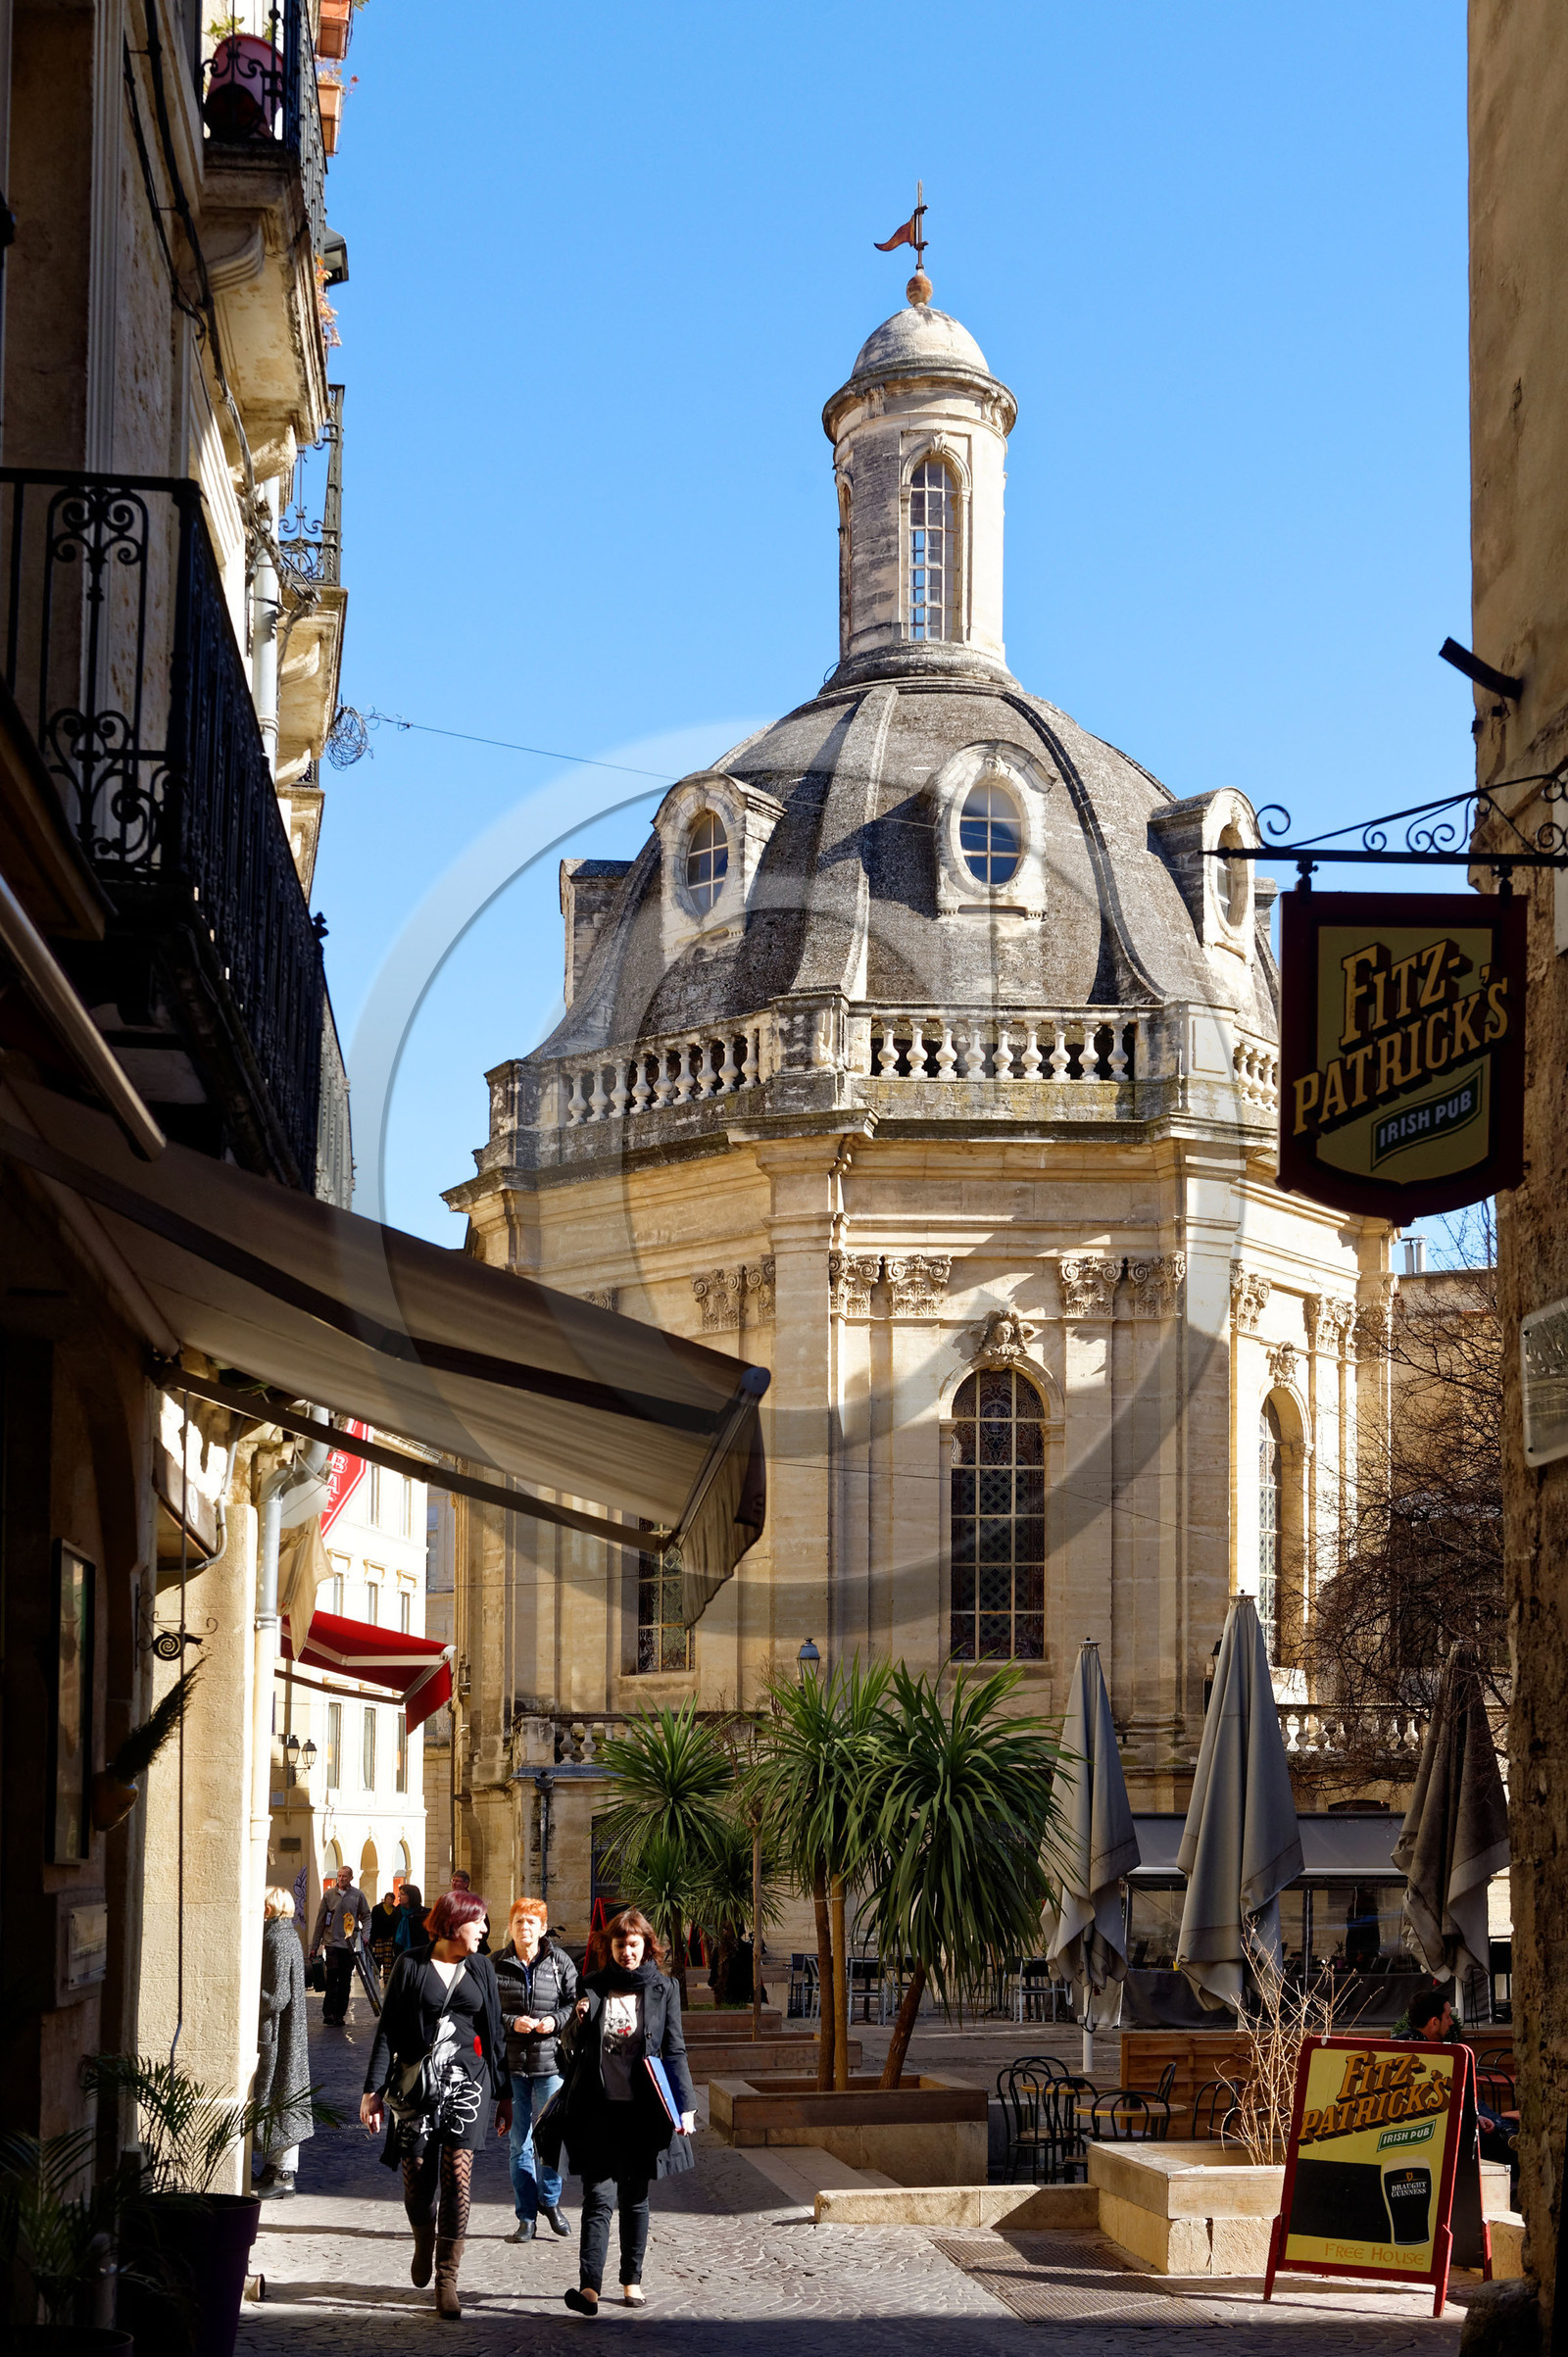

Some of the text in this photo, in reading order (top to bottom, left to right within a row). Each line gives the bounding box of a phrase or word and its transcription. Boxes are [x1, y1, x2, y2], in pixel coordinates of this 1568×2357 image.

[1293, 962, 1509, 1137] PATRICK'S
[1379, 1088, 1473, 1149] IRISH PUB
[1297, 2070, 1452, 2142] PATRICK'S
[1382, 2127, 1431, 2144] IRISH PUB
[1391, 2181, 1427, 2193] DRAUGHT
[1391, 2187, 1427, 2198] GUINNESS
[1324, 2241, 1426, 2266] FREE HOUSE
